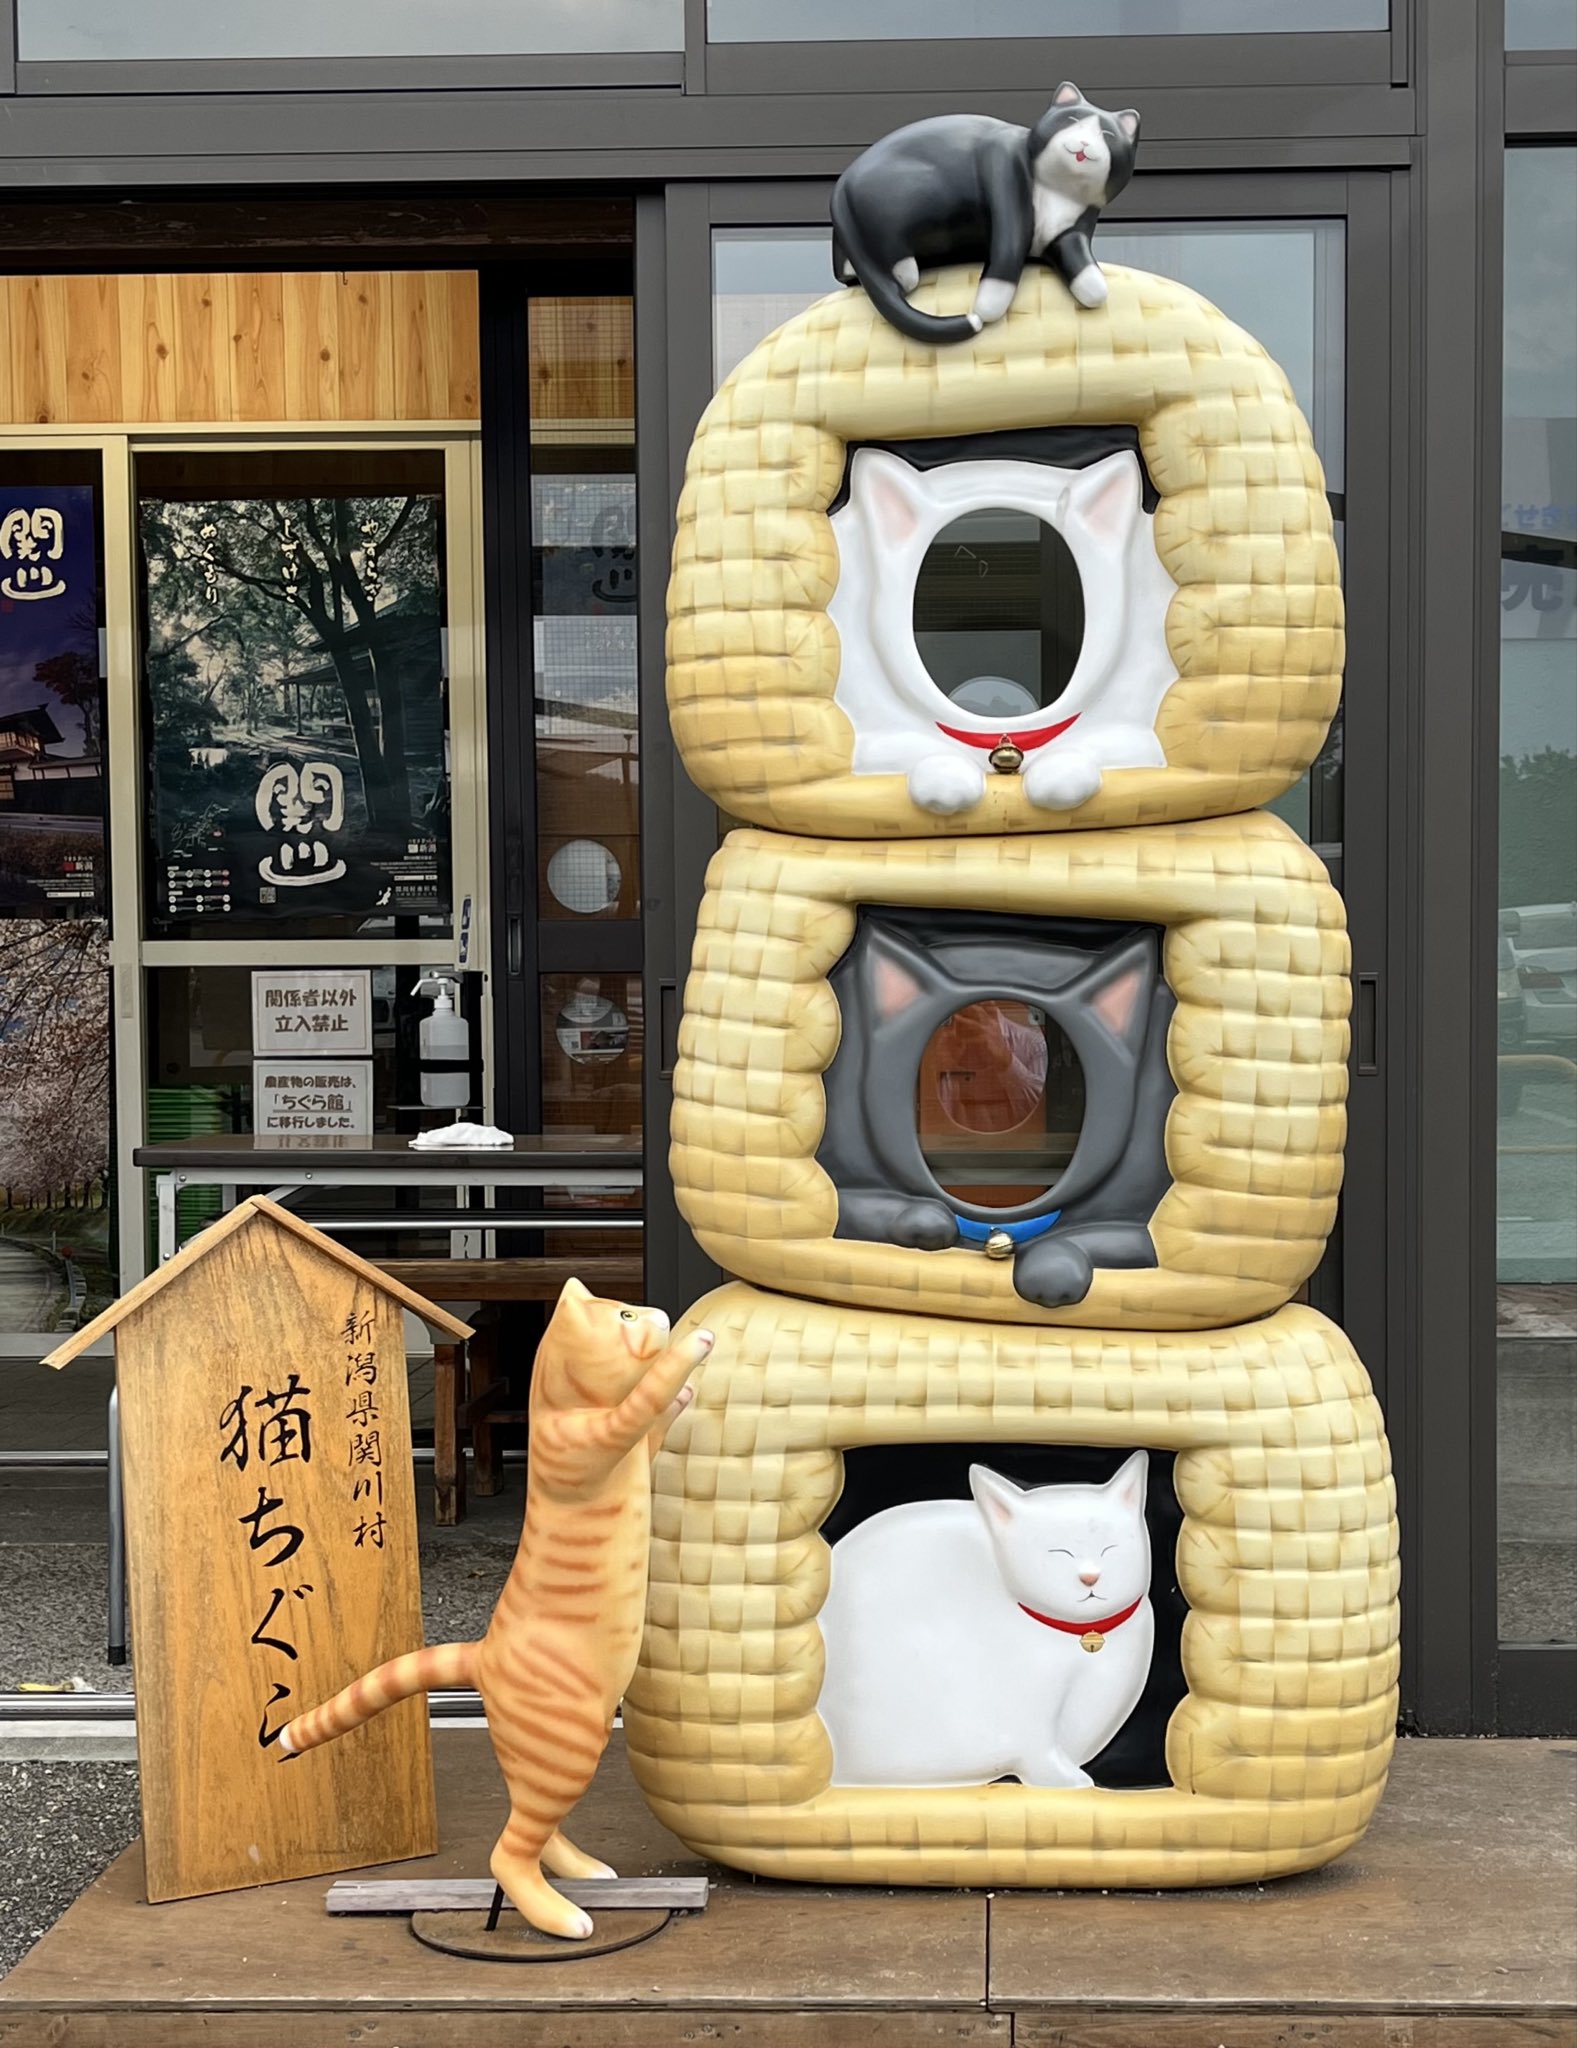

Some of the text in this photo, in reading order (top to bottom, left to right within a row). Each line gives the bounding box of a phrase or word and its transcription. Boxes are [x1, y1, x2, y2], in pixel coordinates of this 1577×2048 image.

[200, 523, 218, 604] ぬくもり
[281, 519, 299, 603] しずけさ
[361, 519, 382, 602] やすらぎ
[265, 989, 357, 1008] 関係者以外
[275, 1015, 349, 1033] 立入禁止
[265, 1075, 357, 1088] 農産物の販売は、
[273, 1093, 353, 1111] 「ちぐら館」
[267, 1116, 356, 1129] に移行しました。
[341, 1310, 387, 1549] 新潟県関川村
[220, 1374, 314, 1763] 猫ちぐら
